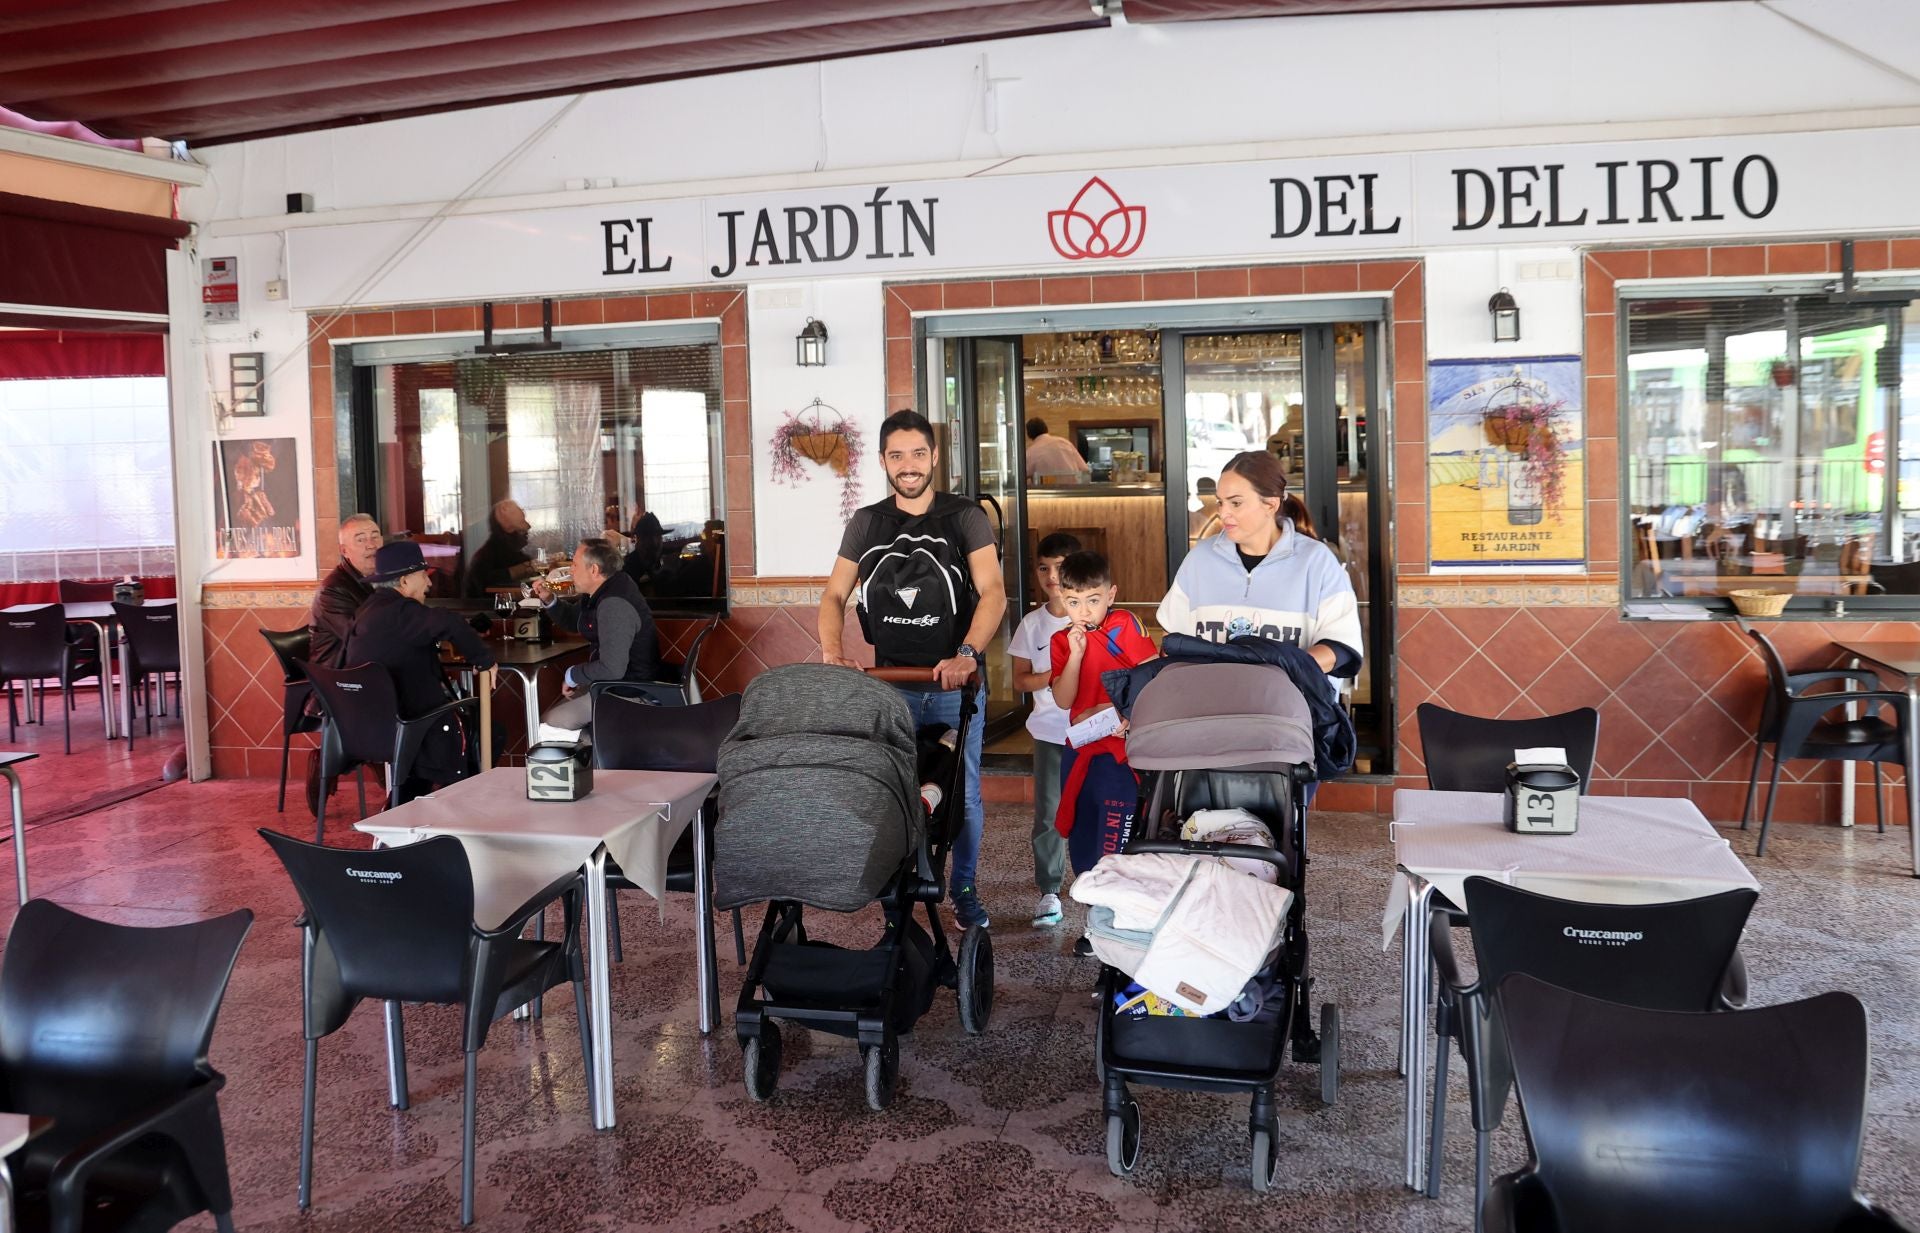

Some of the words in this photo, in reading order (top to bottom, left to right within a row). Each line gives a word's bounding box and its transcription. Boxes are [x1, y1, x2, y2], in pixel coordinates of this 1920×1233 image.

[600, 217, 672, 275] EL
[711, 187, 939, 278] JARDÍN
[1270, 174, 1401, 239] DEL
[1451, 154, 1778, 231] DELIRIO
[1461, 532, 1552, 541] RESTAURANTE
[1472, 543, 1487, 552] EL
[518, 621, 531, 635] 6
[530, 766, 570, 797] 12
[1527, 793, 1555, 828] 13
[346, 867, 403, 880] Cruzcampo
[1563, 926, 1644, 941] Cruzcampo
